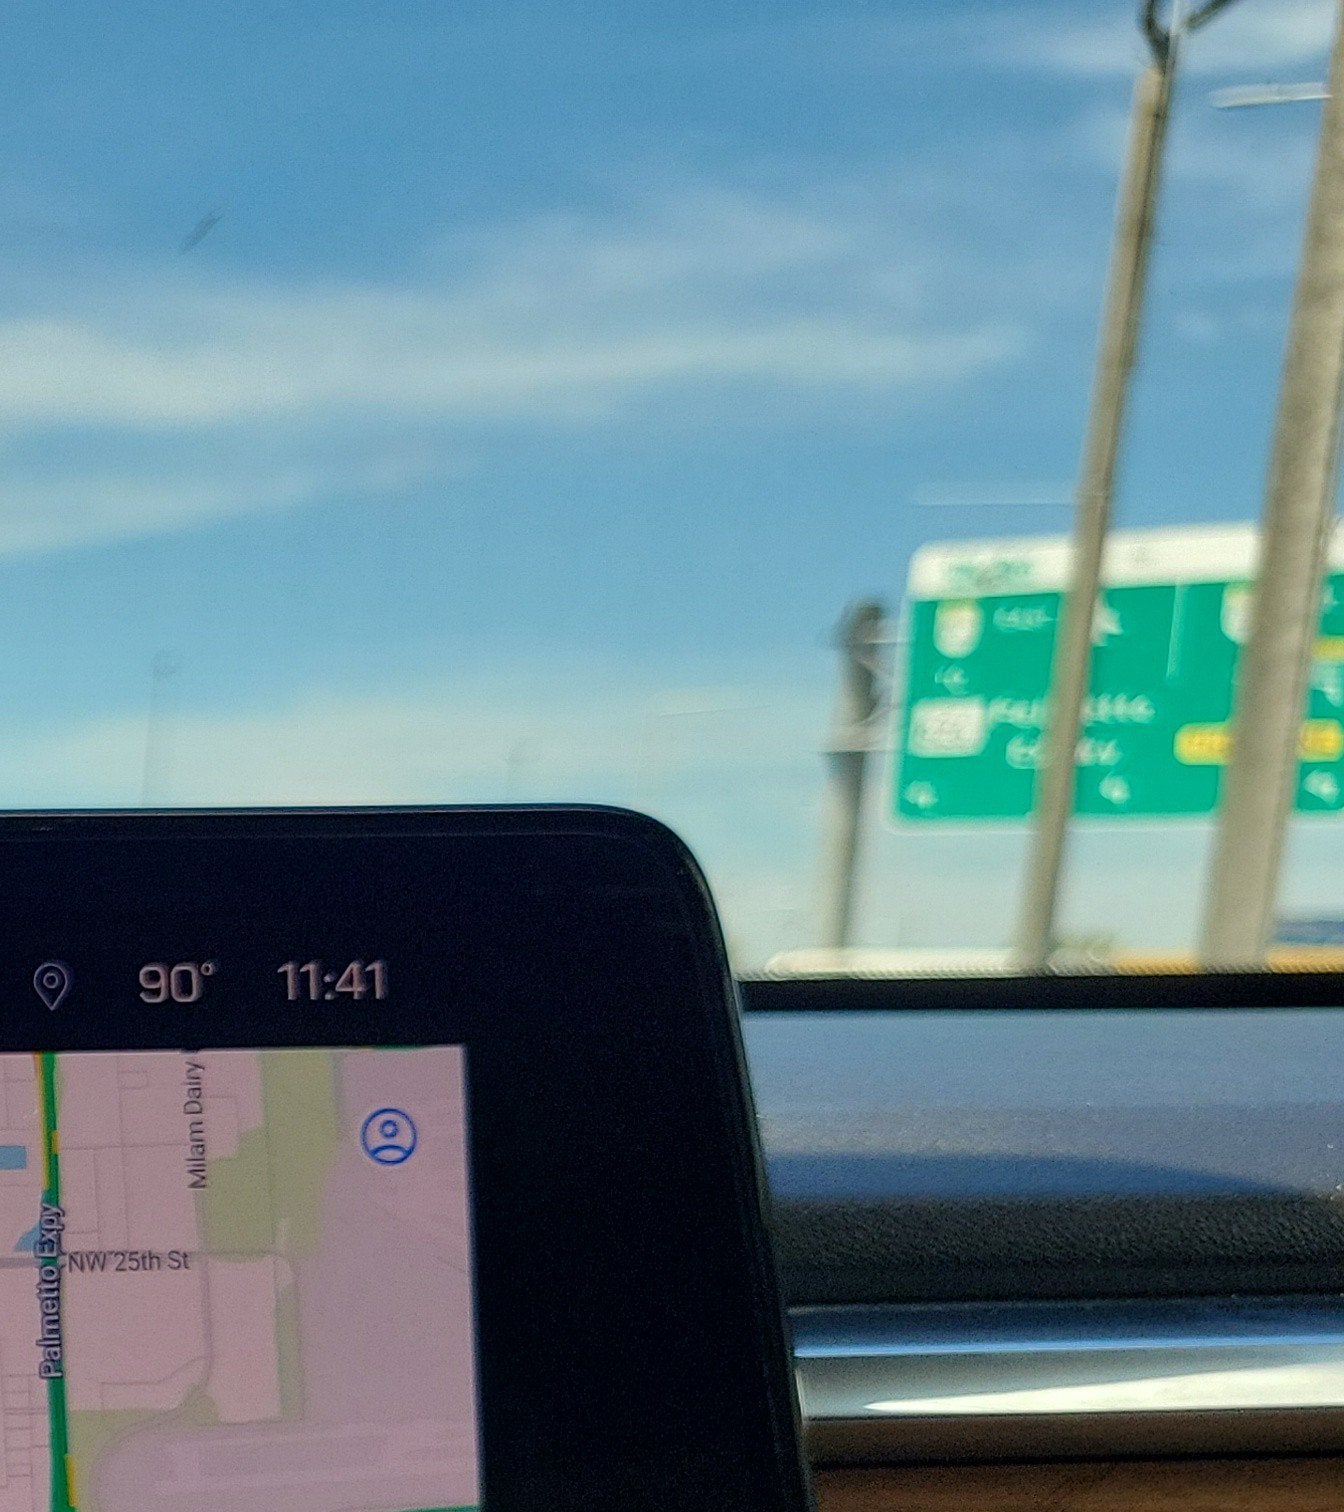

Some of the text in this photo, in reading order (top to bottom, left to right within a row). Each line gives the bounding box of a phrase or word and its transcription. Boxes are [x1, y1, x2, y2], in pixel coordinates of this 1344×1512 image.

[138, 960, 216, 1003] 90°
[276, 958, 389, 1001] 11:41
[182, 1060, 207, 1188] Milam Dairy
[68, 1250, 189, 1271] NW 25th St
[34, 1203, 65, 1379] Palmetto Expy
